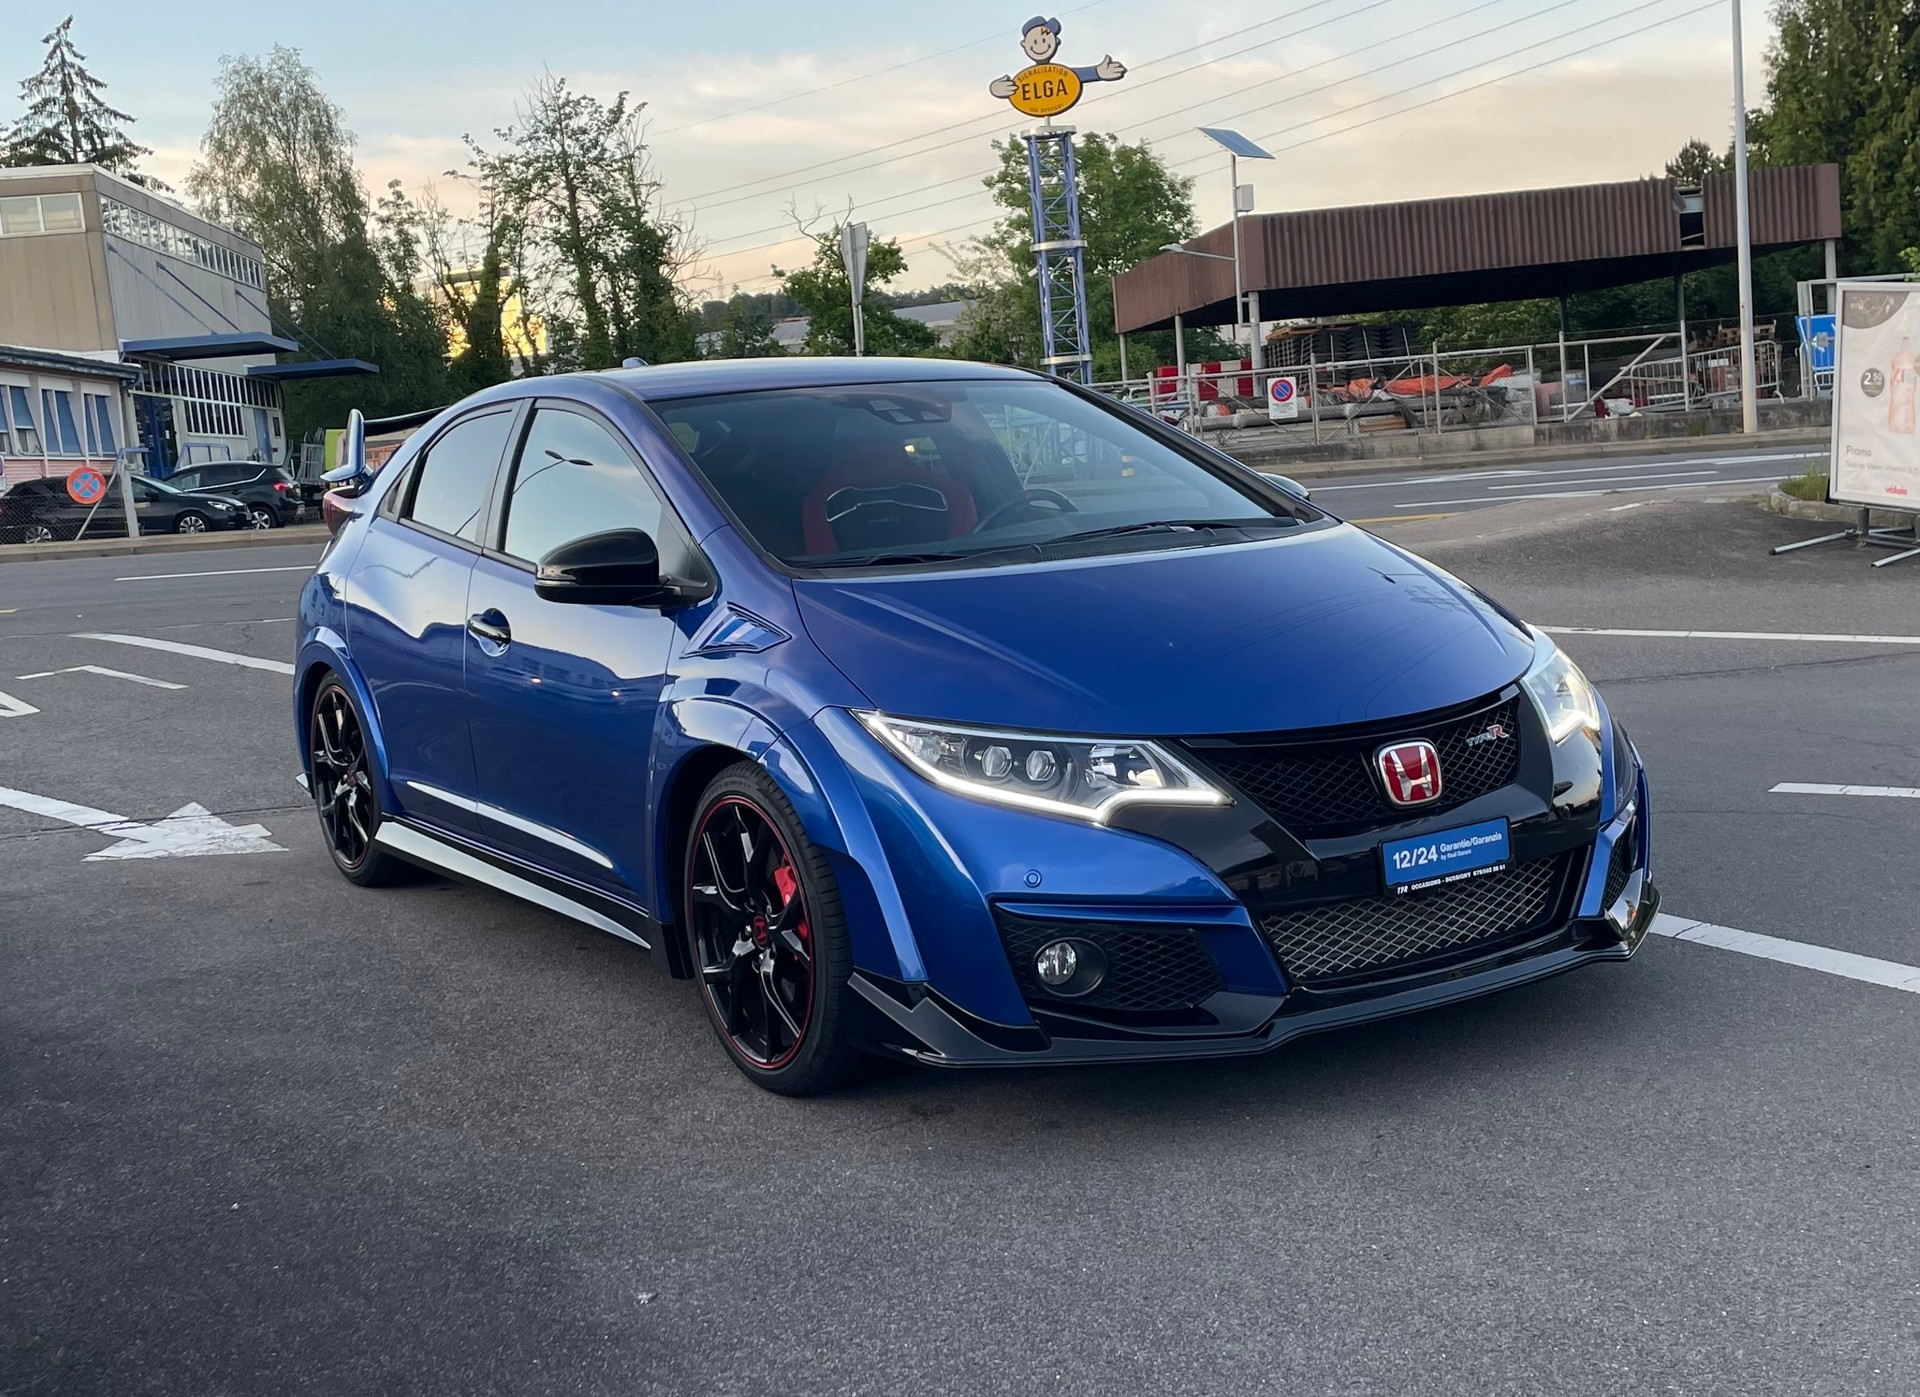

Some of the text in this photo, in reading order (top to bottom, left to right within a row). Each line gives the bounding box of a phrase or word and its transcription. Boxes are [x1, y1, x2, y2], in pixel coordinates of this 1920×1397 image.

[1017, 66, 1070, 83] SIGNALISATION
[1021, 78, 1068, 101] ELGA
[1846, 445, 1872, 457] Promo
[1392, 832, 1502, 870] 12/24 Garantie/Garanzia
[1411, 878, 1441, 891] OCCASIONS
